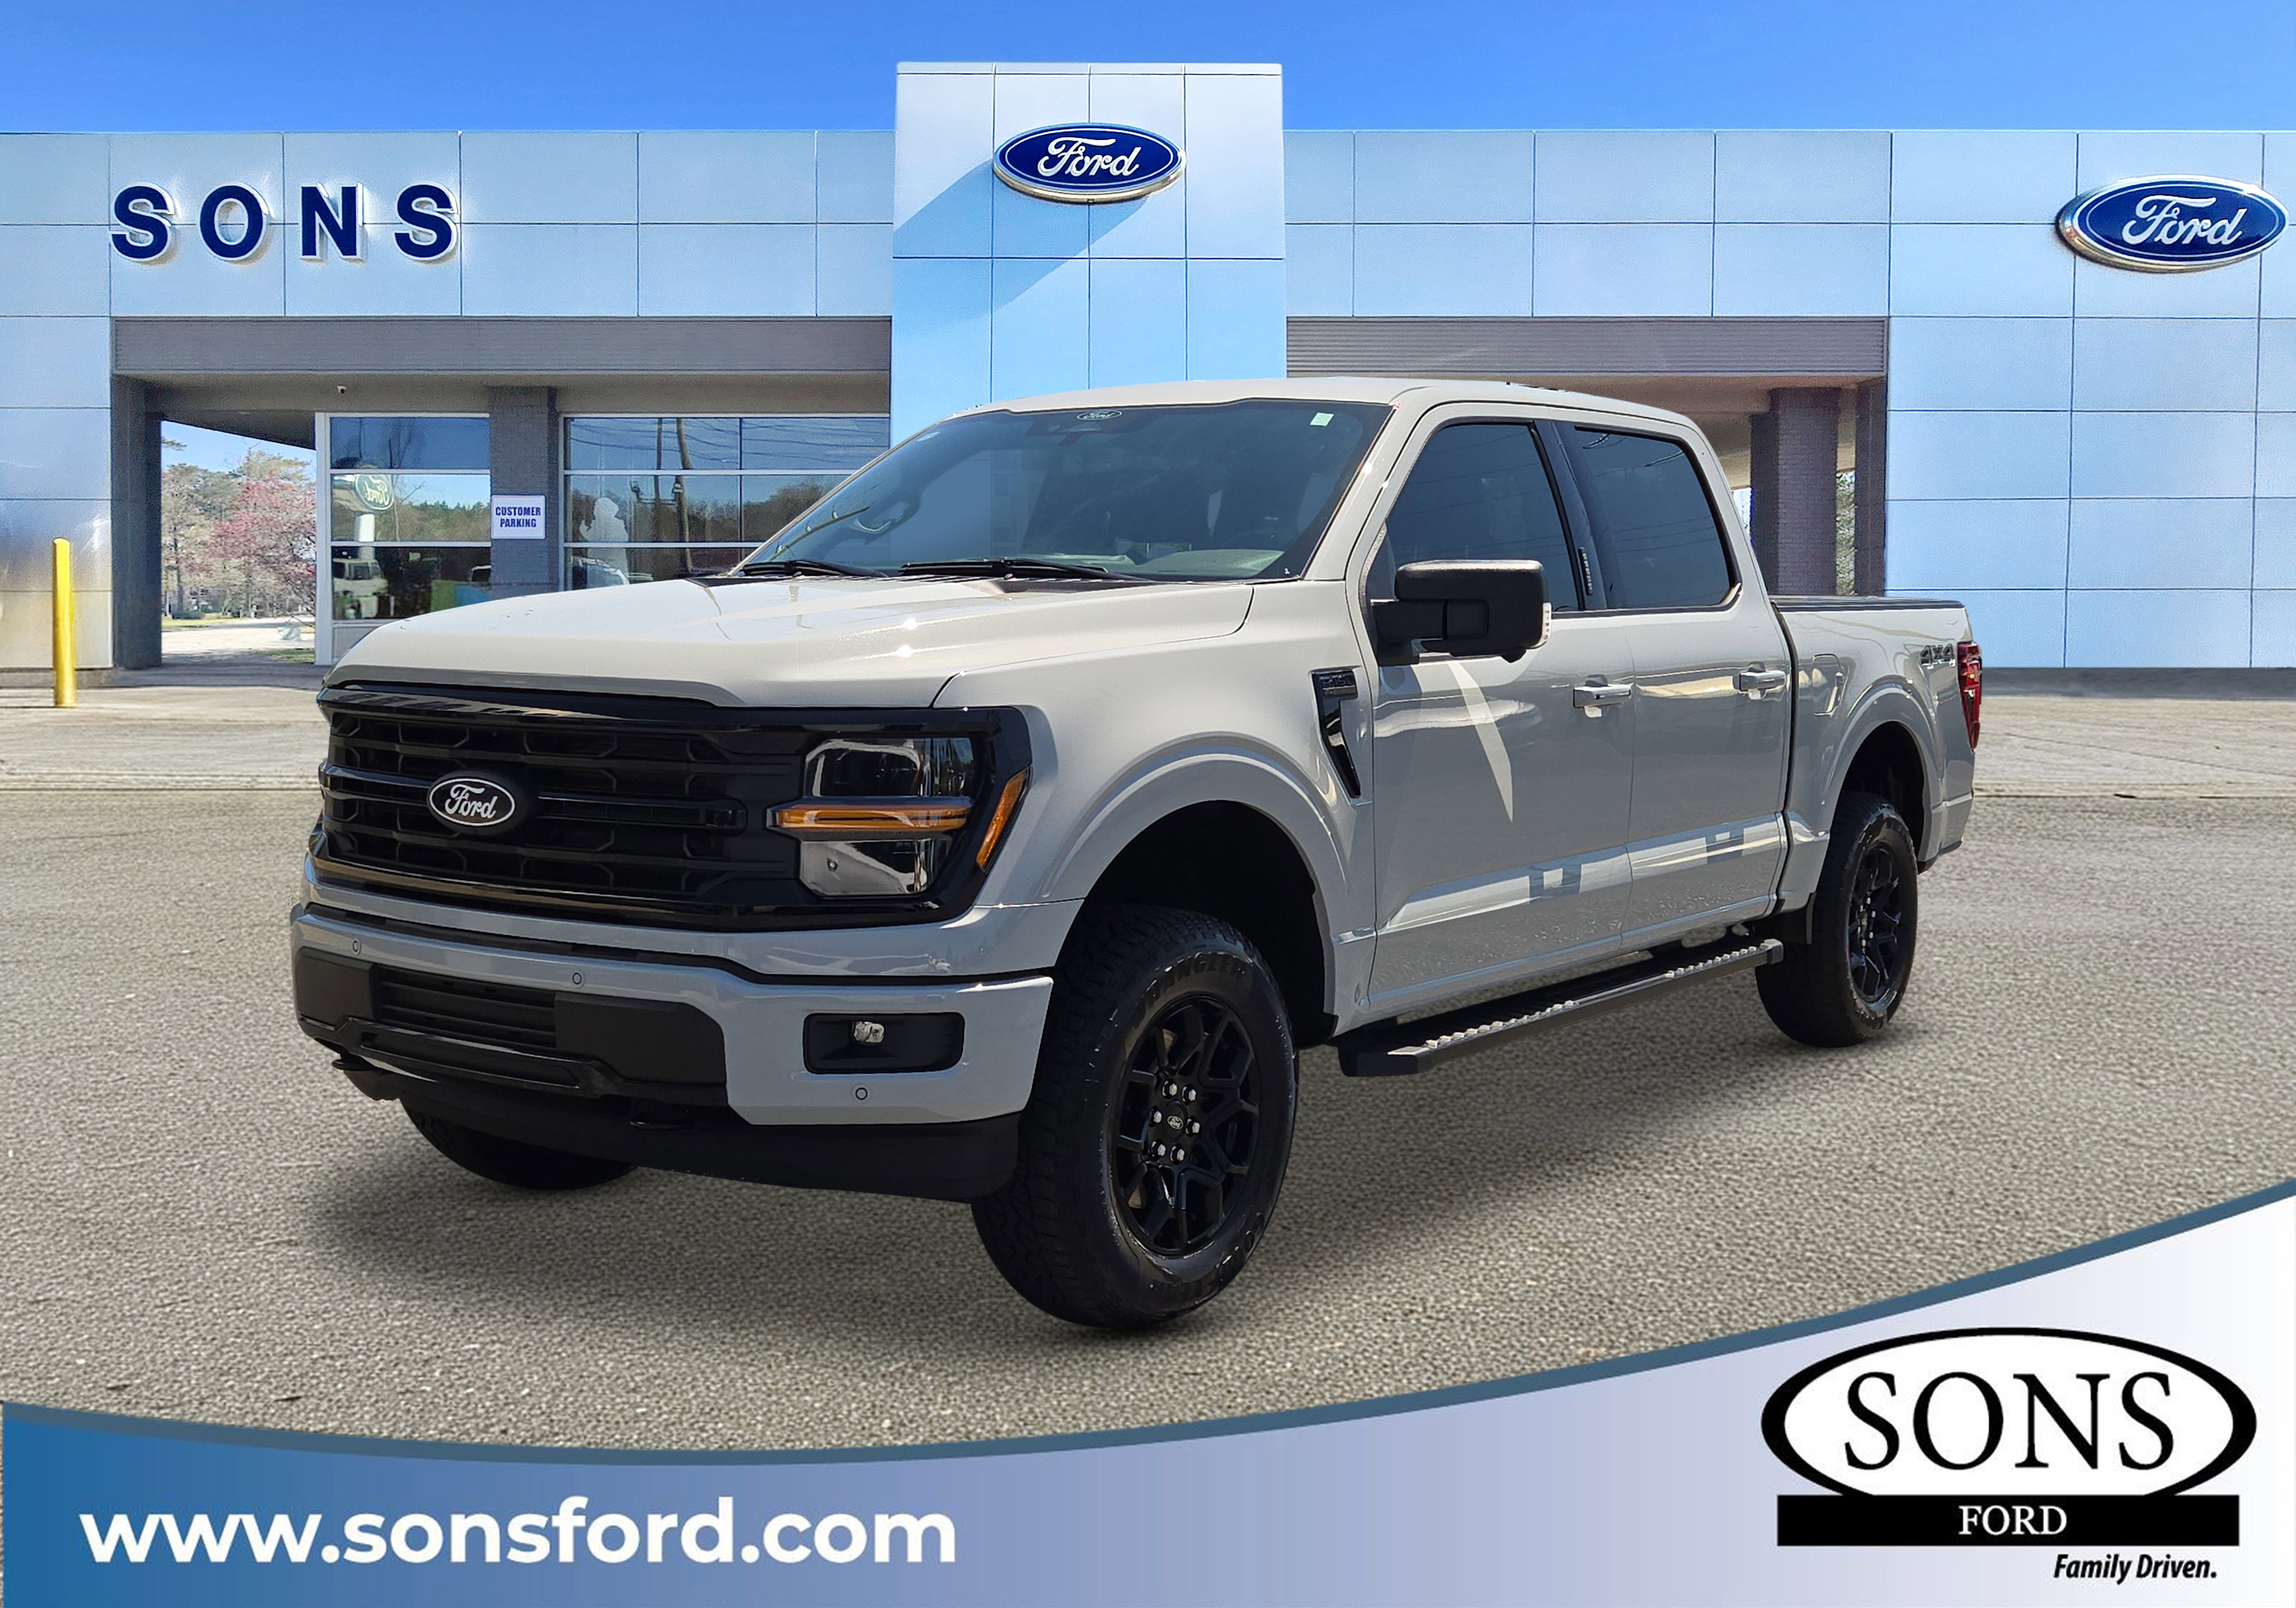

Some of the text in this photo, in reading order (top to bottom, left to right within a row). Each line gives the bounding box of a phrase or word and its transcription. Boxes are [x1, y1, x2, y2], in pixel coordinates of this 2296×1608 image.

[1037, 136, 1142, 177] Ford
[110, 182, 458, 261] SONS
[2122, 195, 2248, 245] Ford
[495, 506, 541, 516] CUSTOMER
[500, 518, 536, 527] PARKING
[444, 784, 498, 818] Ford
